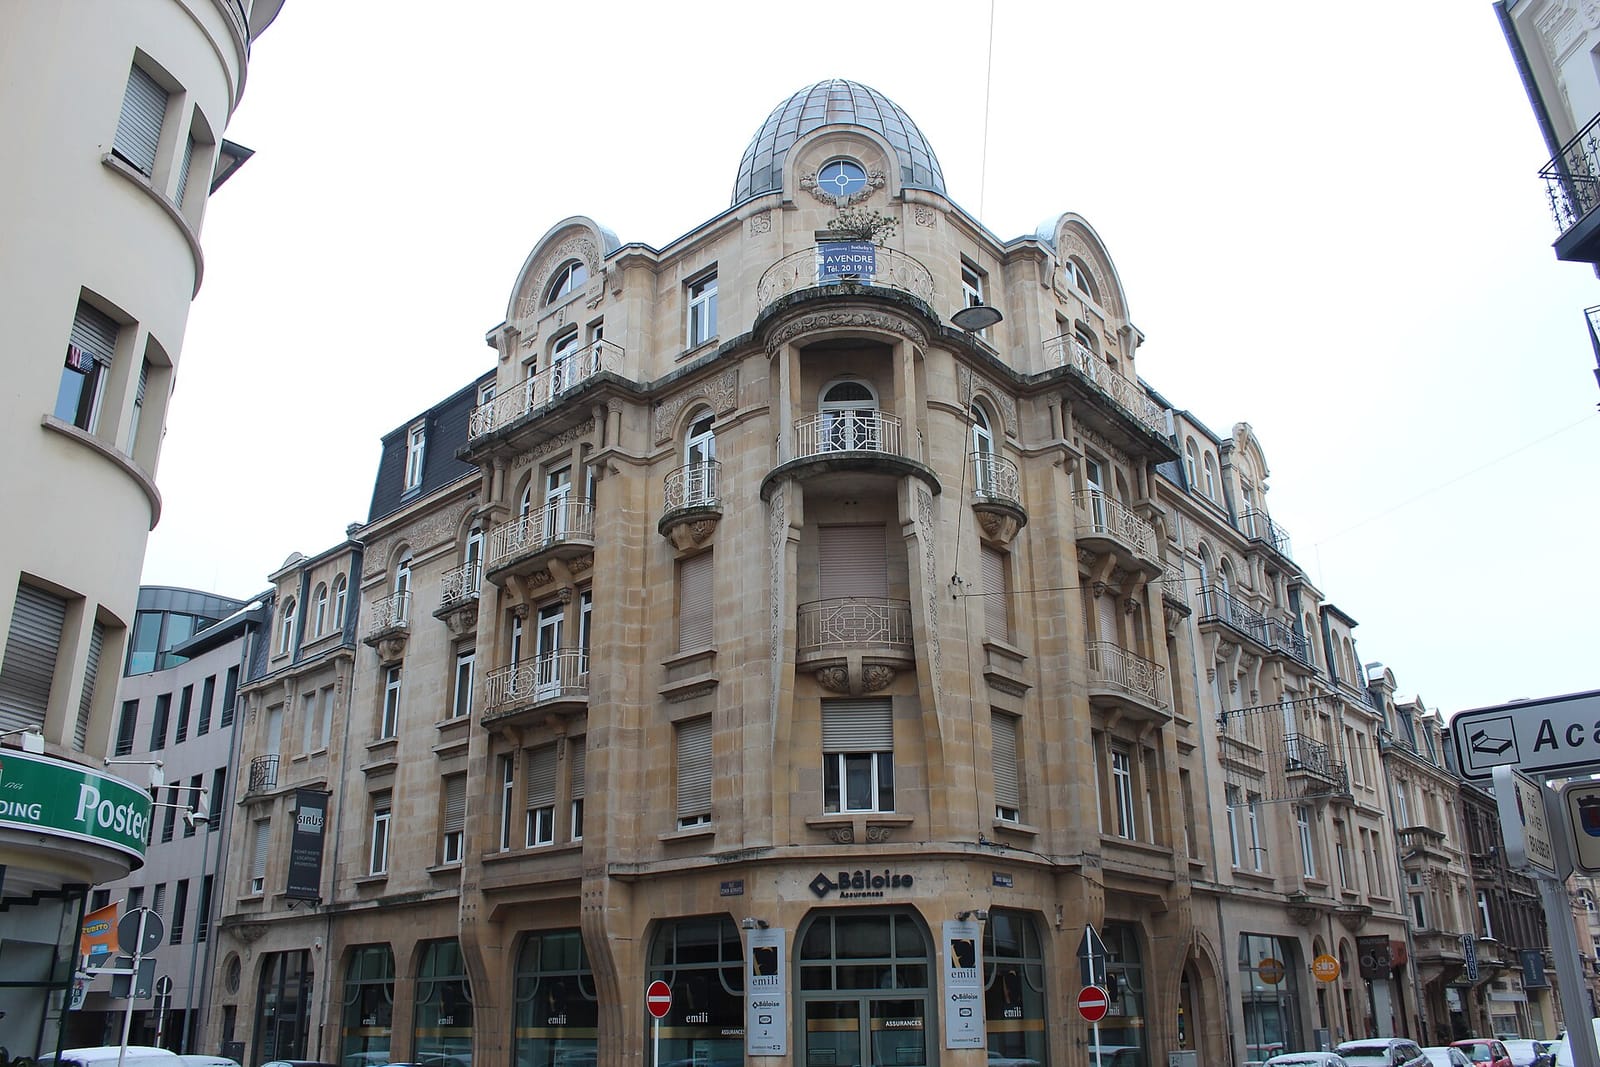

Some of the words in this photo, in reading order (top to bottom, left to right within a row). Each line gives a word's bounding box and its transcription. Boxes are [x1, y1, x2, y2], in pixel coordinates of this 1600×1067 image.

[826, 255, 834, 264] A
[834, 254, 873, 264] VENDRE
[841, 264, 851, 272] 20
[854, 264, 863, 272] 19
[865, 265, 874, 273] 19
[297, 814, 324, 828] SIRUS
[838, 869, 914, 889] Bâloise
[951, 968, 977, 978] emili
[752, 975, 778, 985] emili
[1004, 1006, 1022, 1018] emili
[548, 1014, 567, 1025] emili
[685, 1013, 708, 1023] emili
